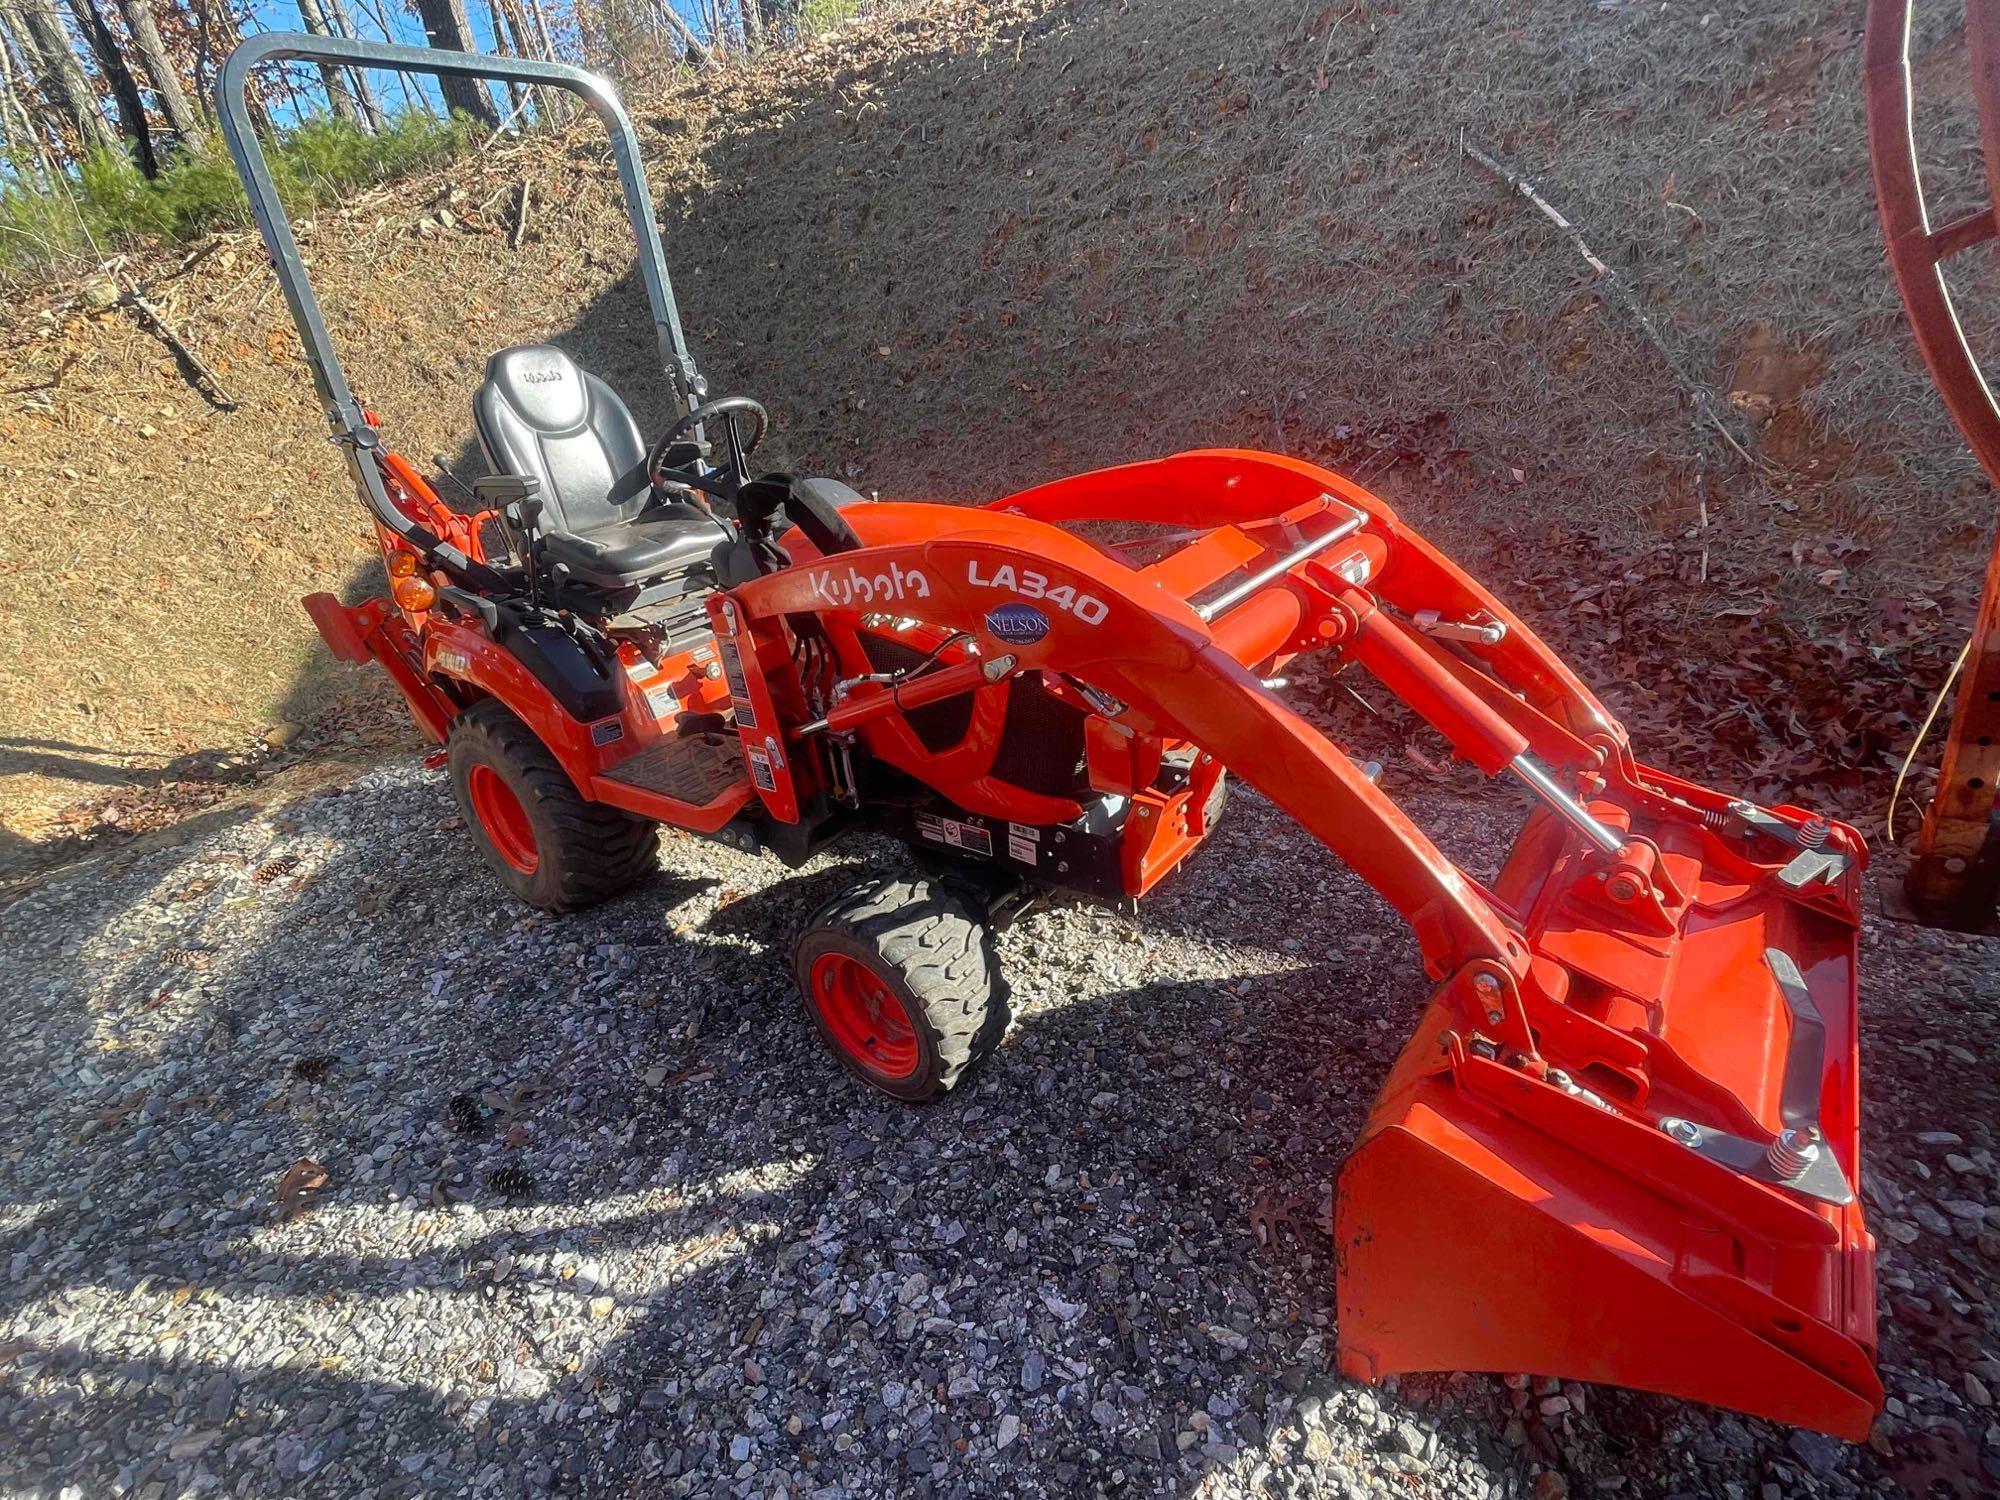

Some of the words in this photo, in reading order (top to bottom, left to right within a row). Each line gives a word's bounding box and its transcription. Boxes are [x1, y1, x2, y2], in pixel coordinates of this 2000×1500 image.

[809, 562, 930, 606] Kubota
[967, 560, 1109, 626] LA340
[984, 613, 1050, 632] NELSON
